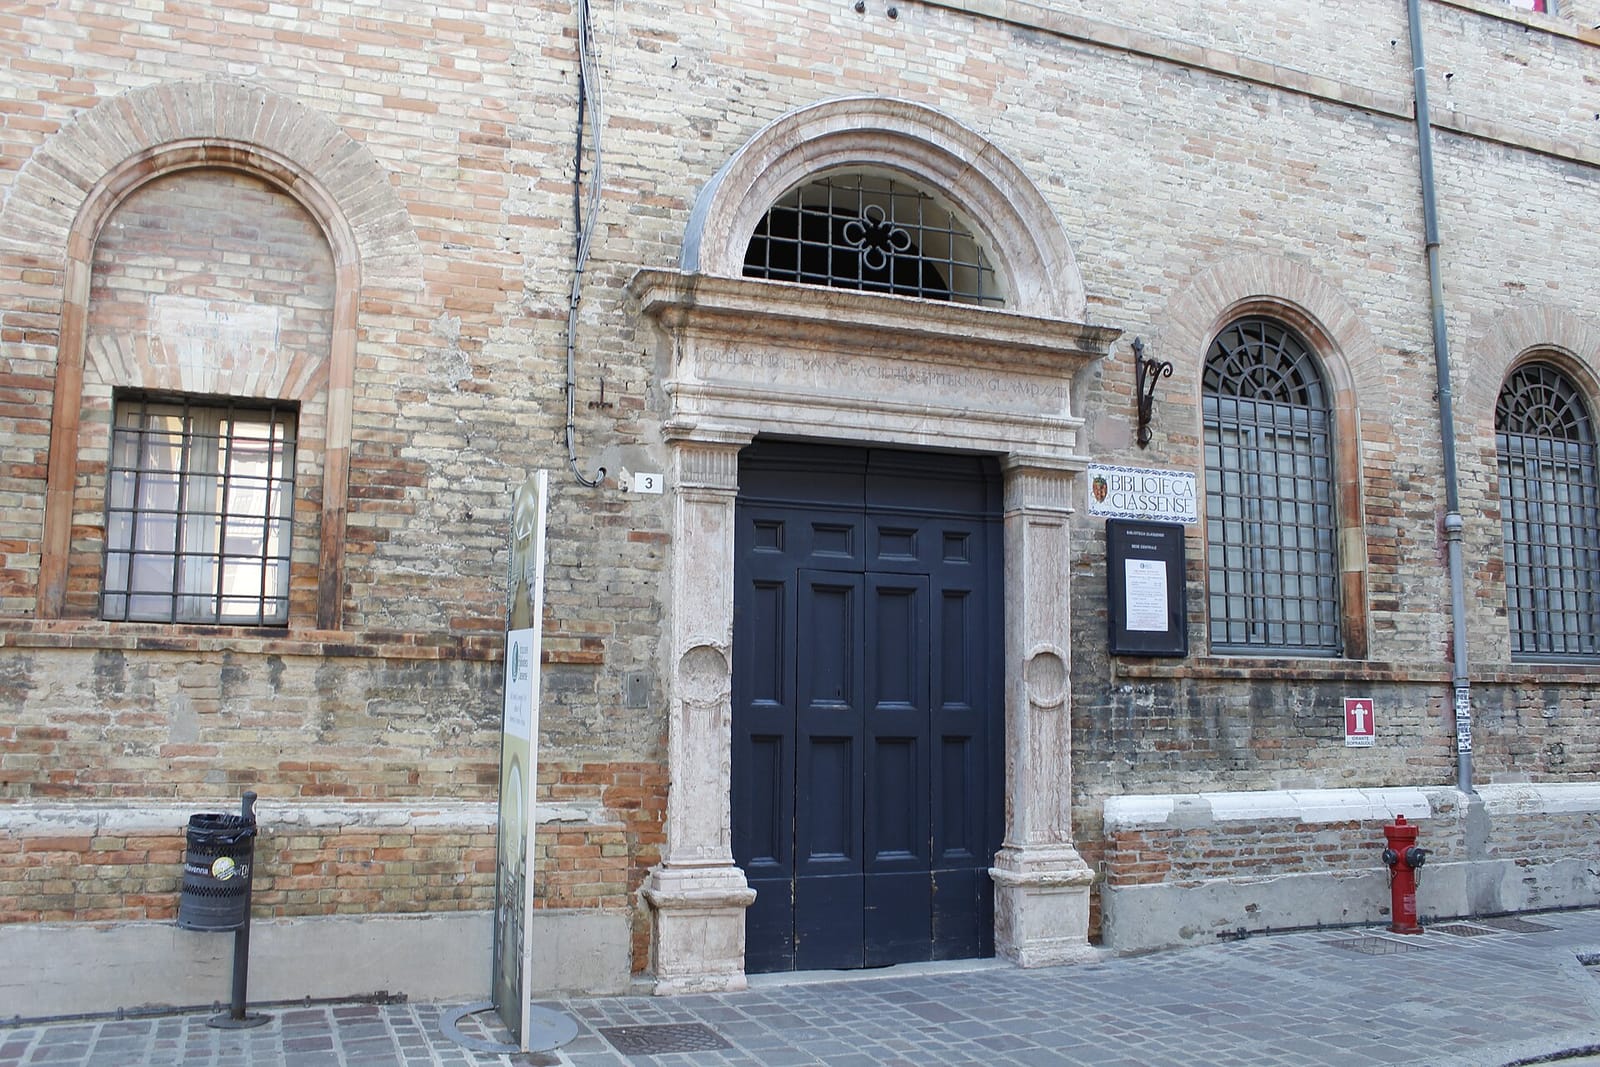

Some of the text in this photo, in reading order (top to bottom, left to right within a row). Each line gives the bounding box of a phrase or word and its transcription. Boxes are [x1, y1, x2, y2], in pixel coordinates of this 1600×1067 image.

[644, 477, 653, 490] 3
[1111, 474, 1193, 498] BIBLIOTECA
[1112, 492, 1193, 515] CLASSENSE
